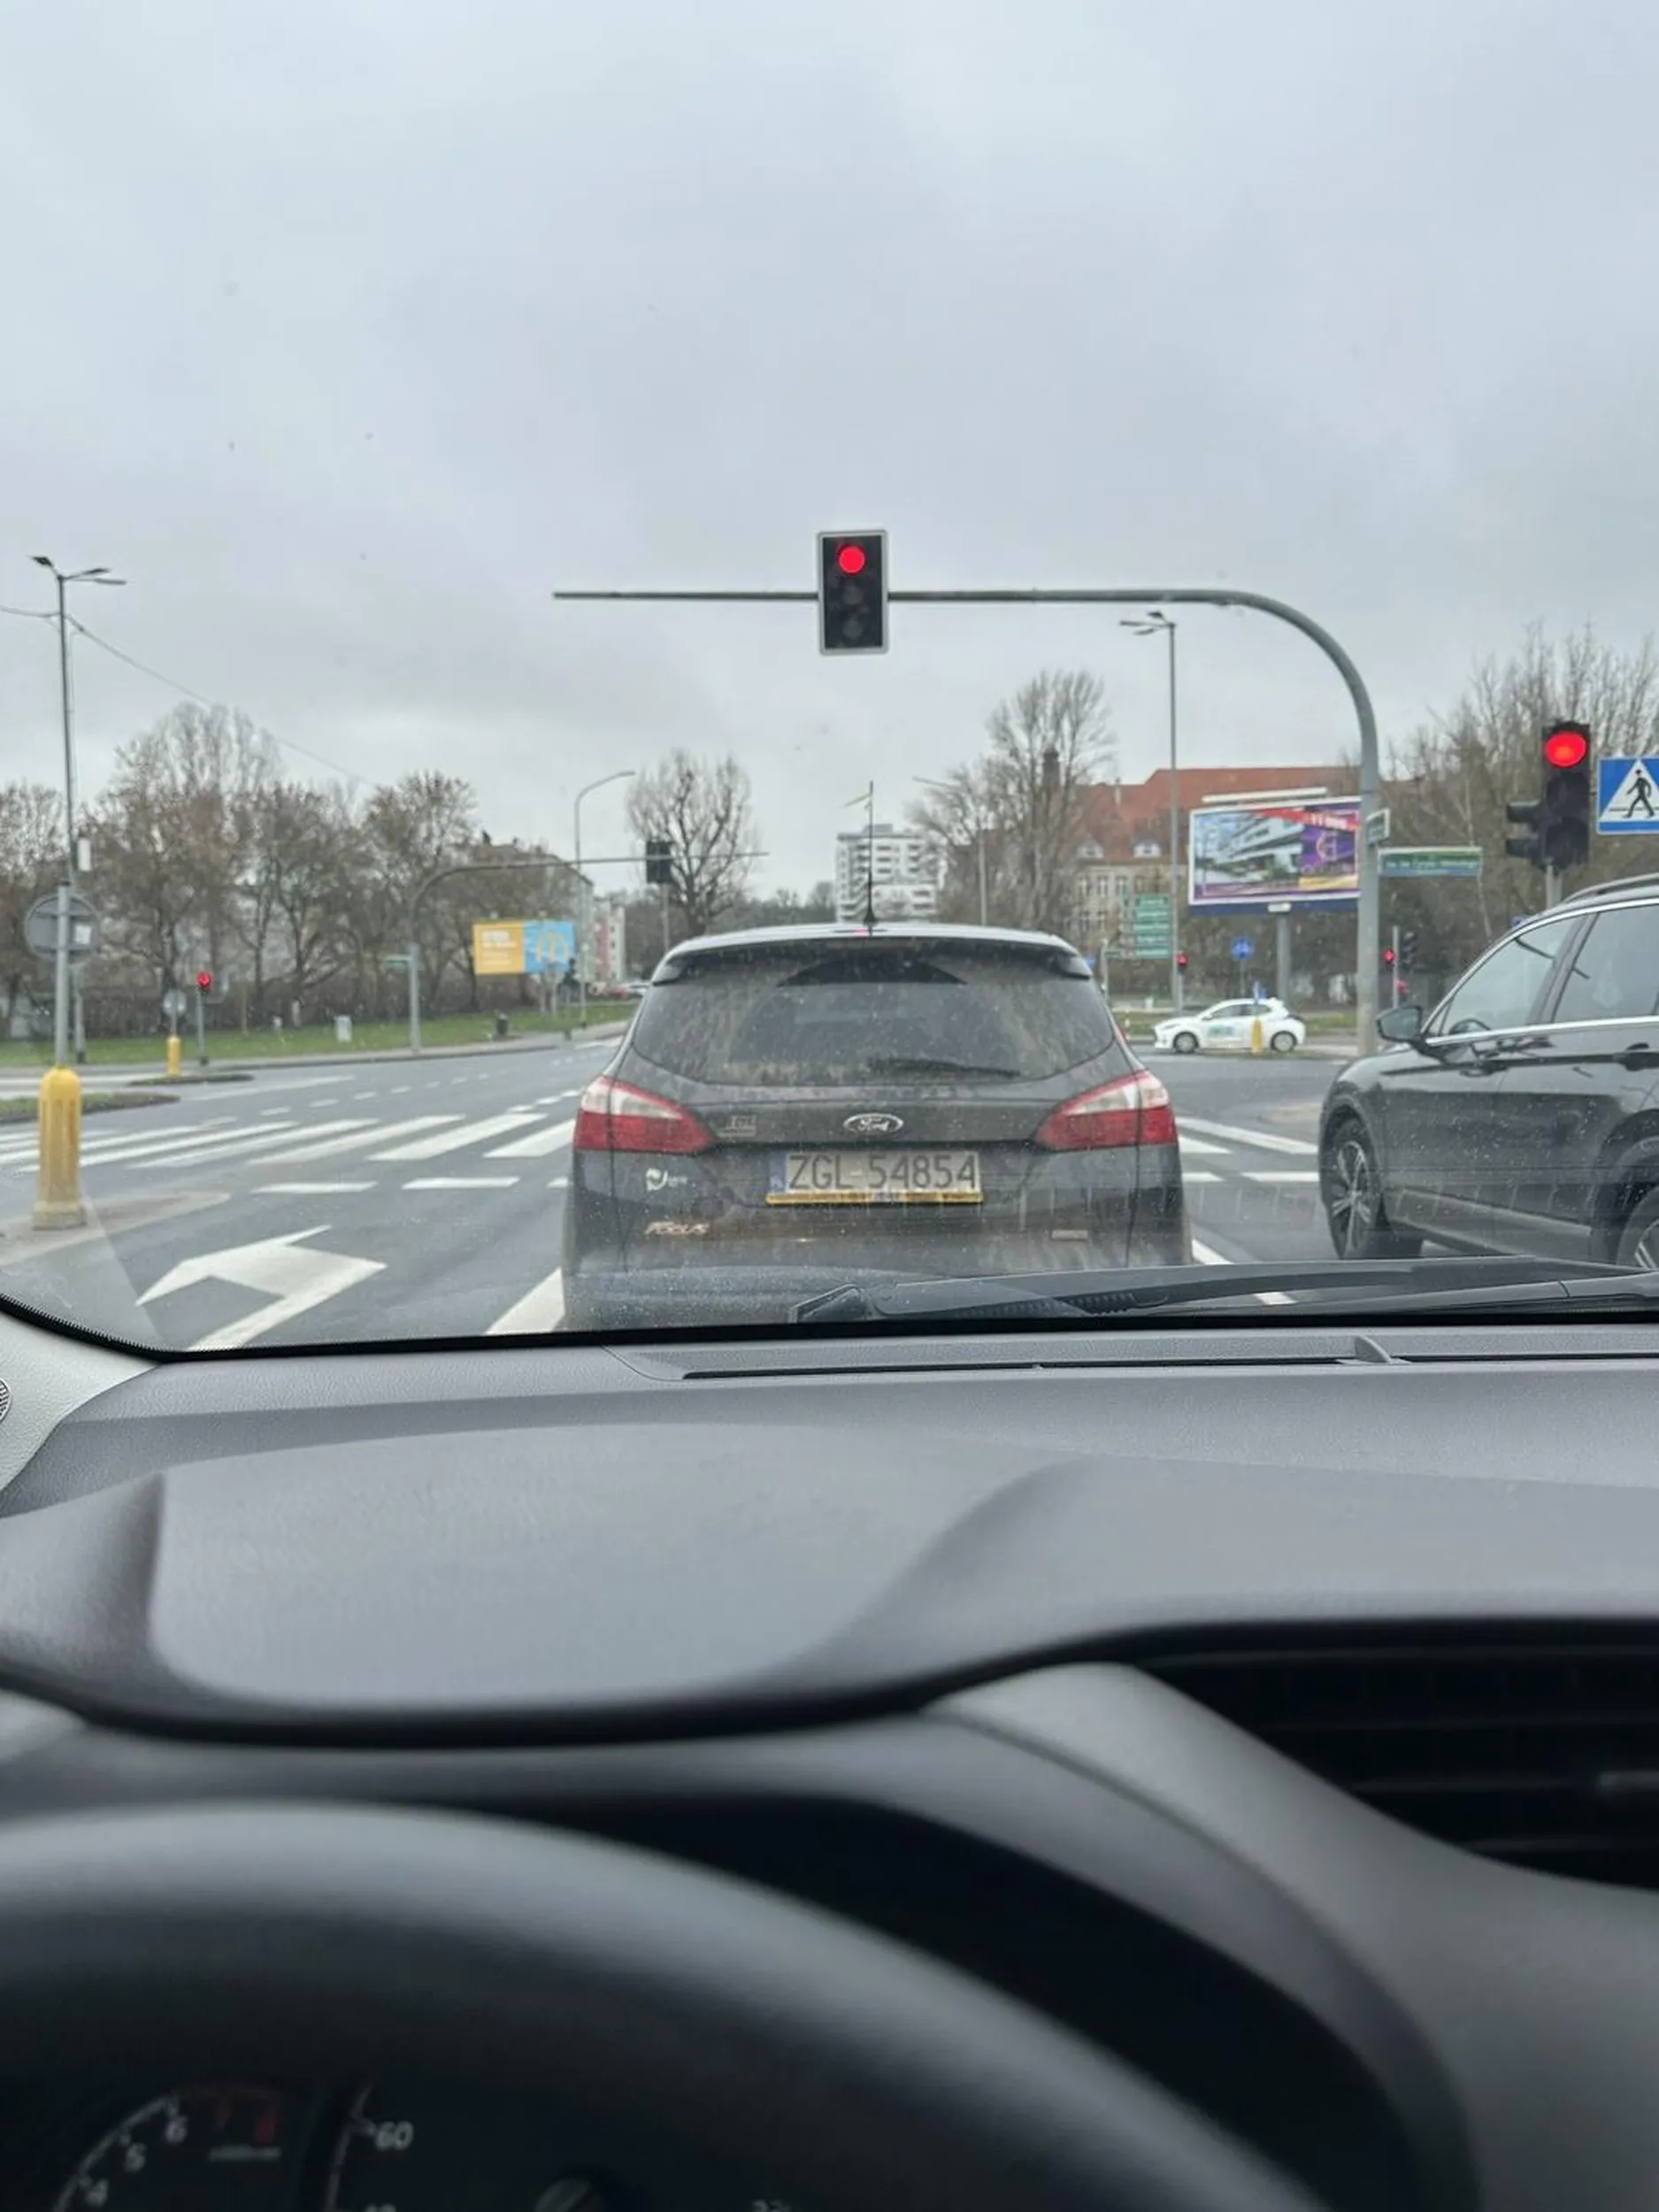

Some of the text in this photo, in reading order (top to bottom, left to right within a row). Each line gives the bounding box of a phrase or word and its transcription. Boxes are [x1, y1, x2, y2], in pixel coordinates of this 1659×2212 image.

[789, 1155, 854, 1190] ZGL
[868, 1154, 975, 1190] 54854
[375, 2120, 414, 2151] 60
